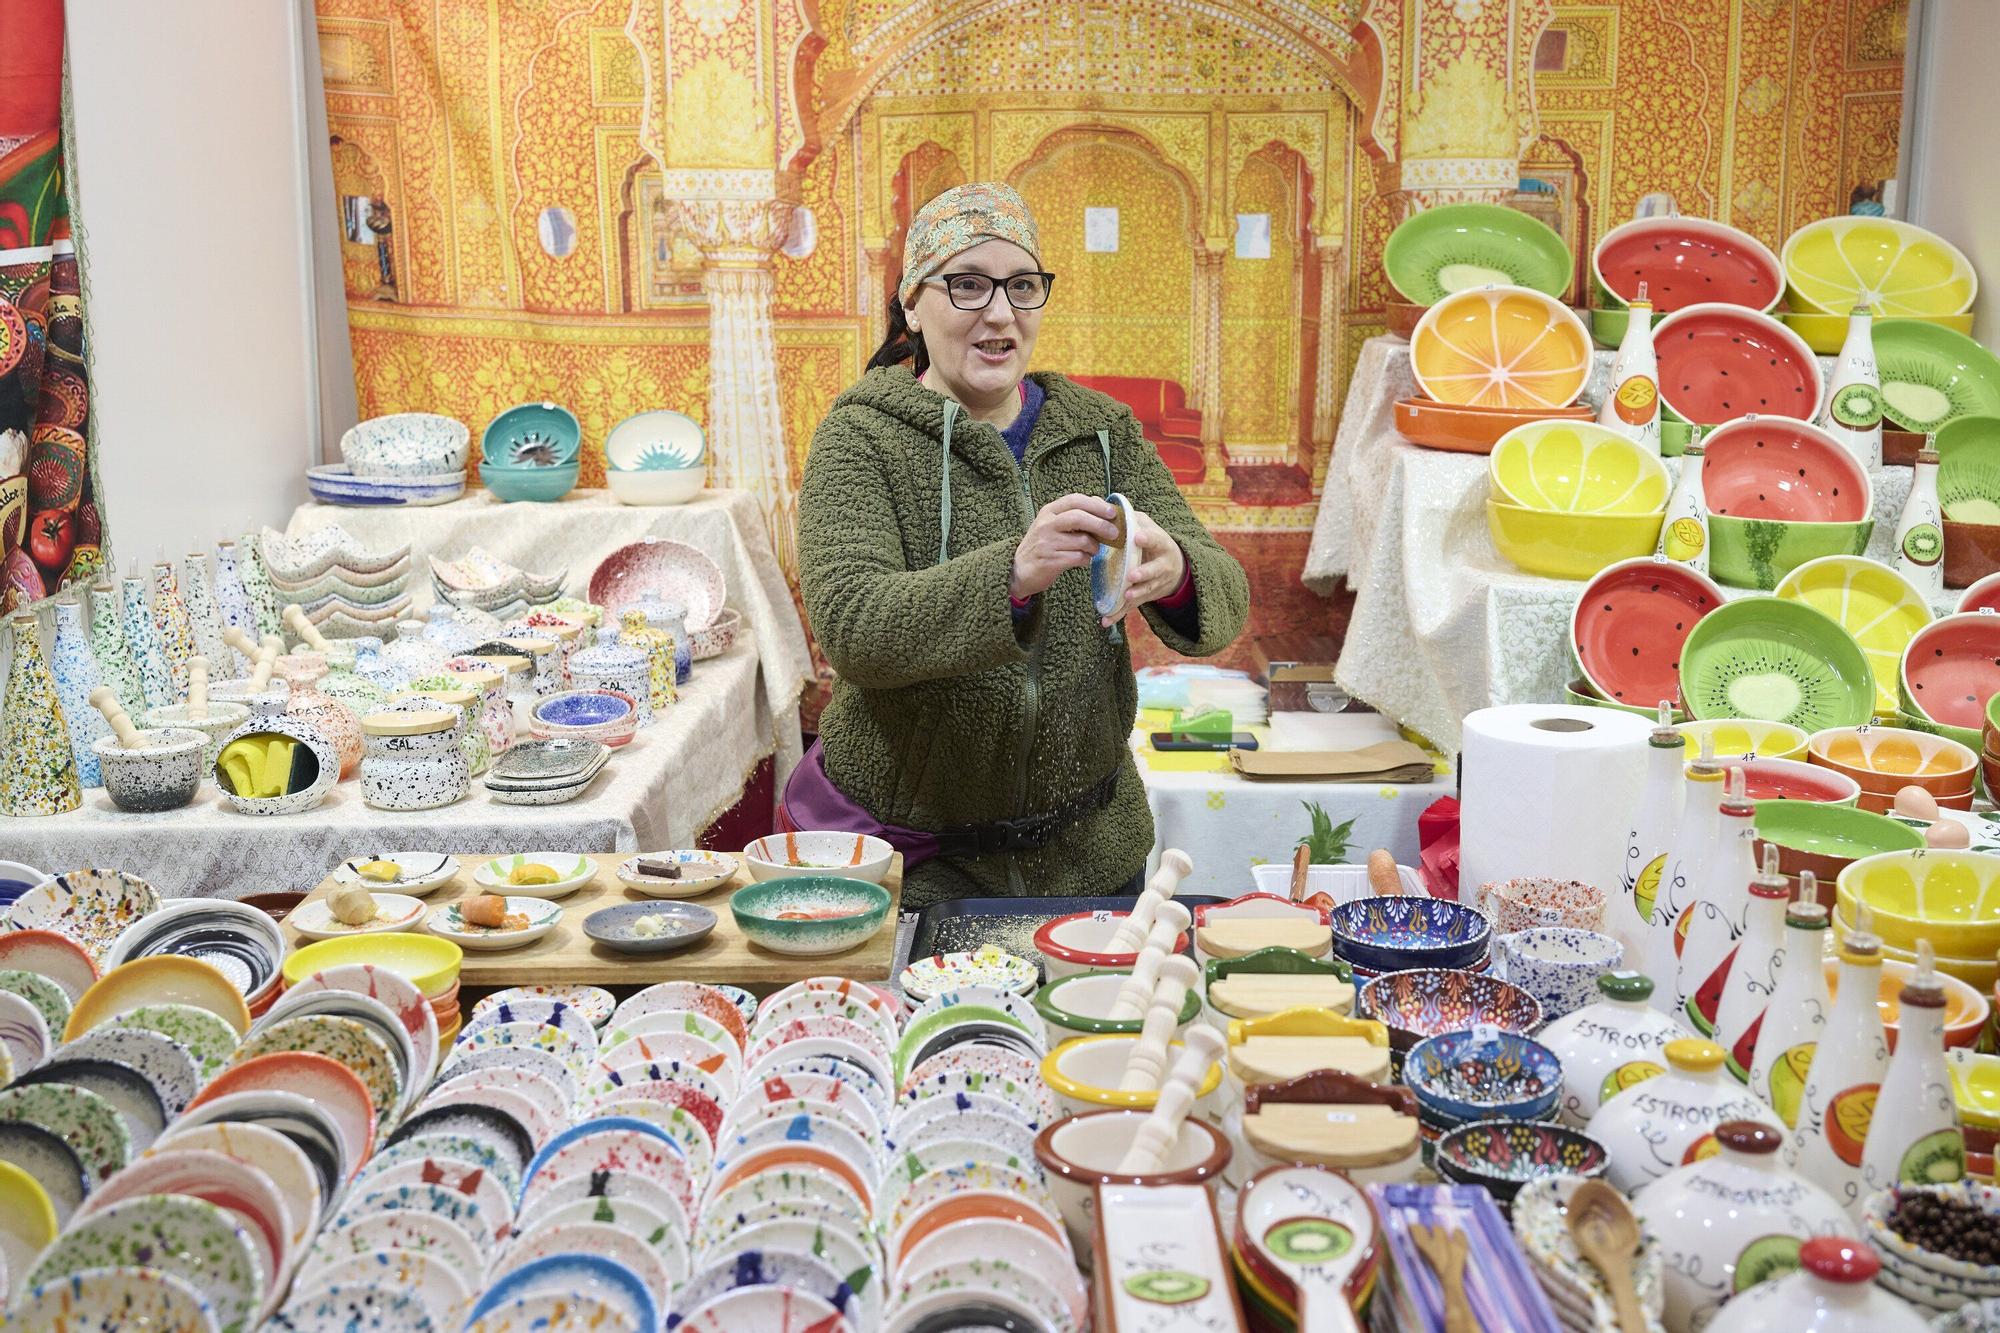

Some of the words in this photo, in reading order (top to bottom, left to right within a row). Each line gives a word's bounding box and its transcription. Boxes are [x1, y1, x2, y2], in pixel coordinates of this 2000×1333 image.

[59, 616, 69, 624] 19
[161, 728, 171, 736] 15
[389, 738, 414, 752] SAL
[1742, 752, 1756, 762] 17
[1738, 829, 1755, 838] 19
[1910, 849, 1926, 859] 17
[1094, 912, 1110, 923] 15
[1543, 912, 1559, 922] 12
